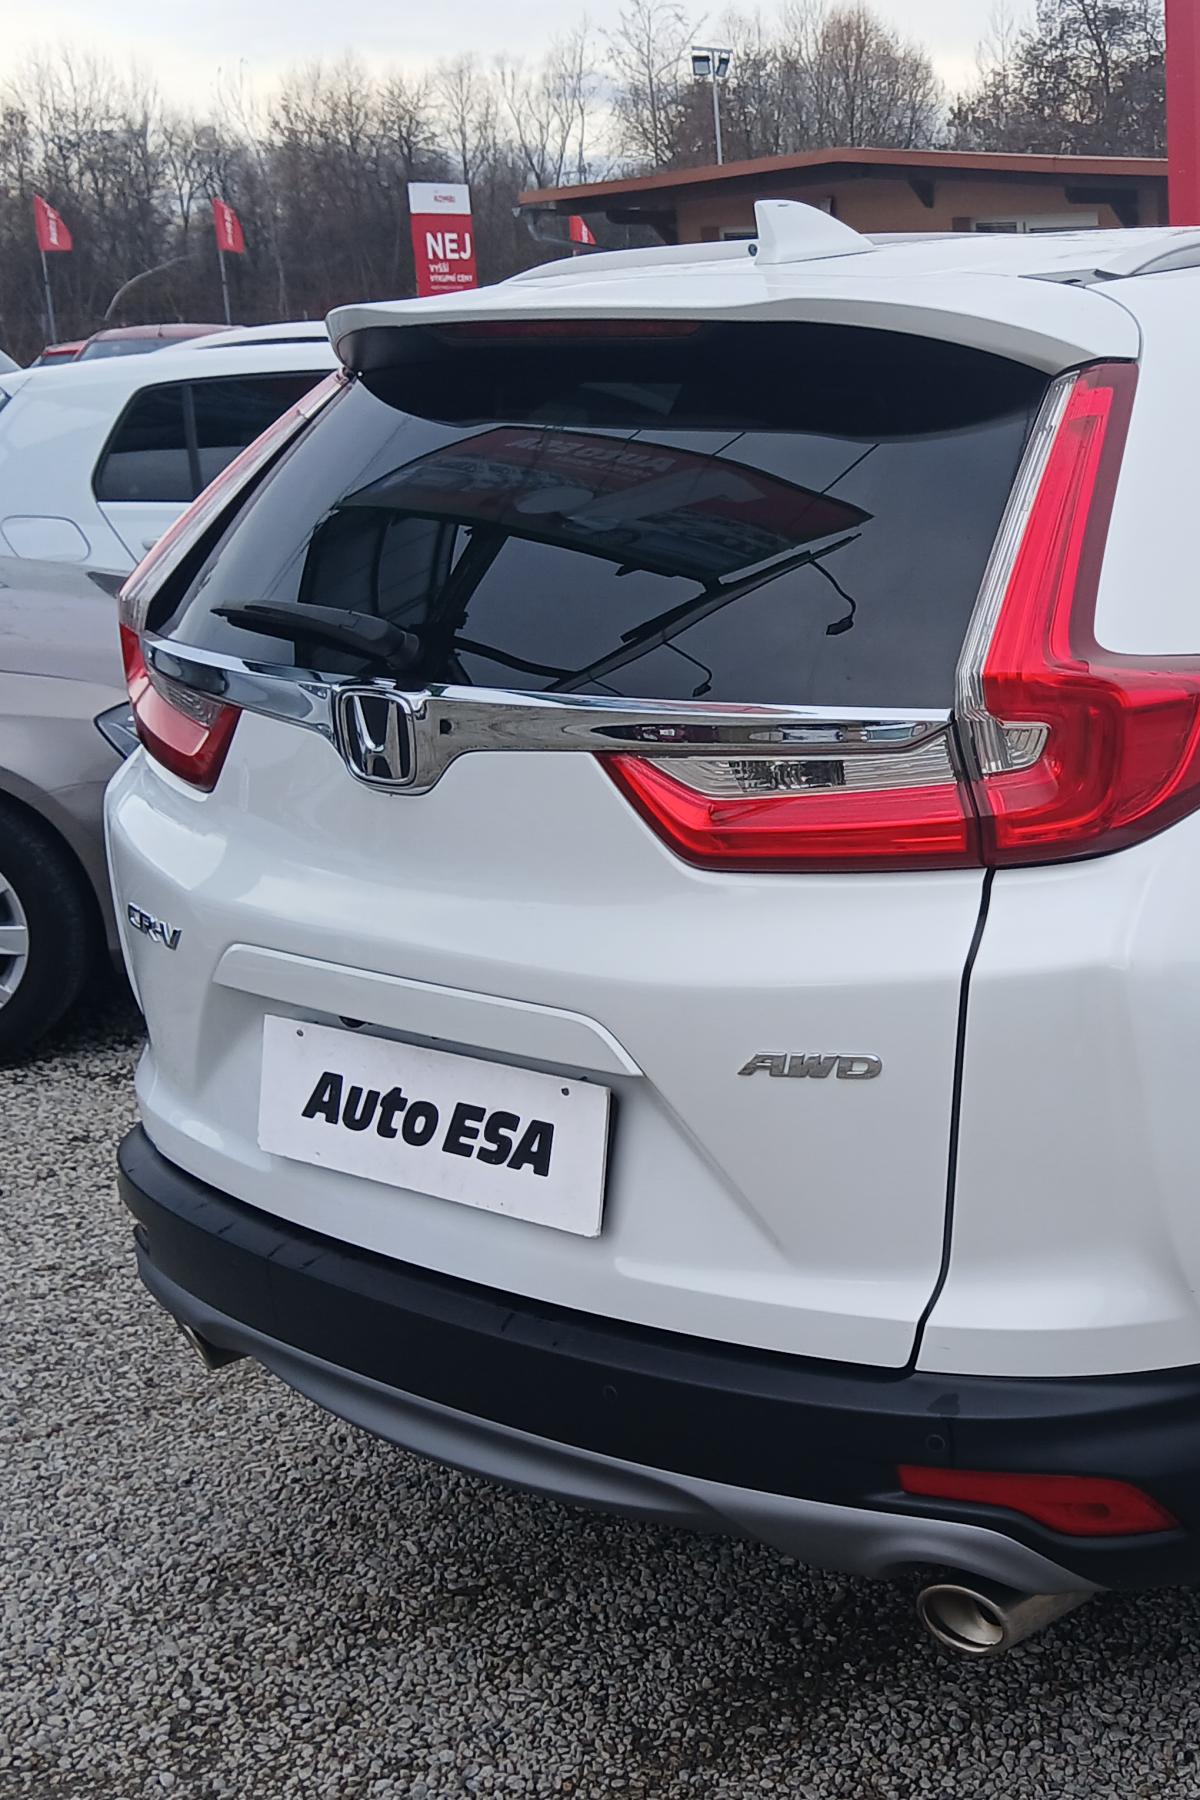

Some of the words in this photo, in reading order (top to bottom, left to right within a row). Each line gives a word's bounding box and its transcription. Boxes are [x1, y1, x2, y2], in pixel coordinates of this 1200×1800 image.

[425, 231, 472, 260] NEJ
[737, 1051, 883, 1080] AWD
[301, 1070, 440, 1147] Auto
[441, 1101, 555, 1178] ESA
